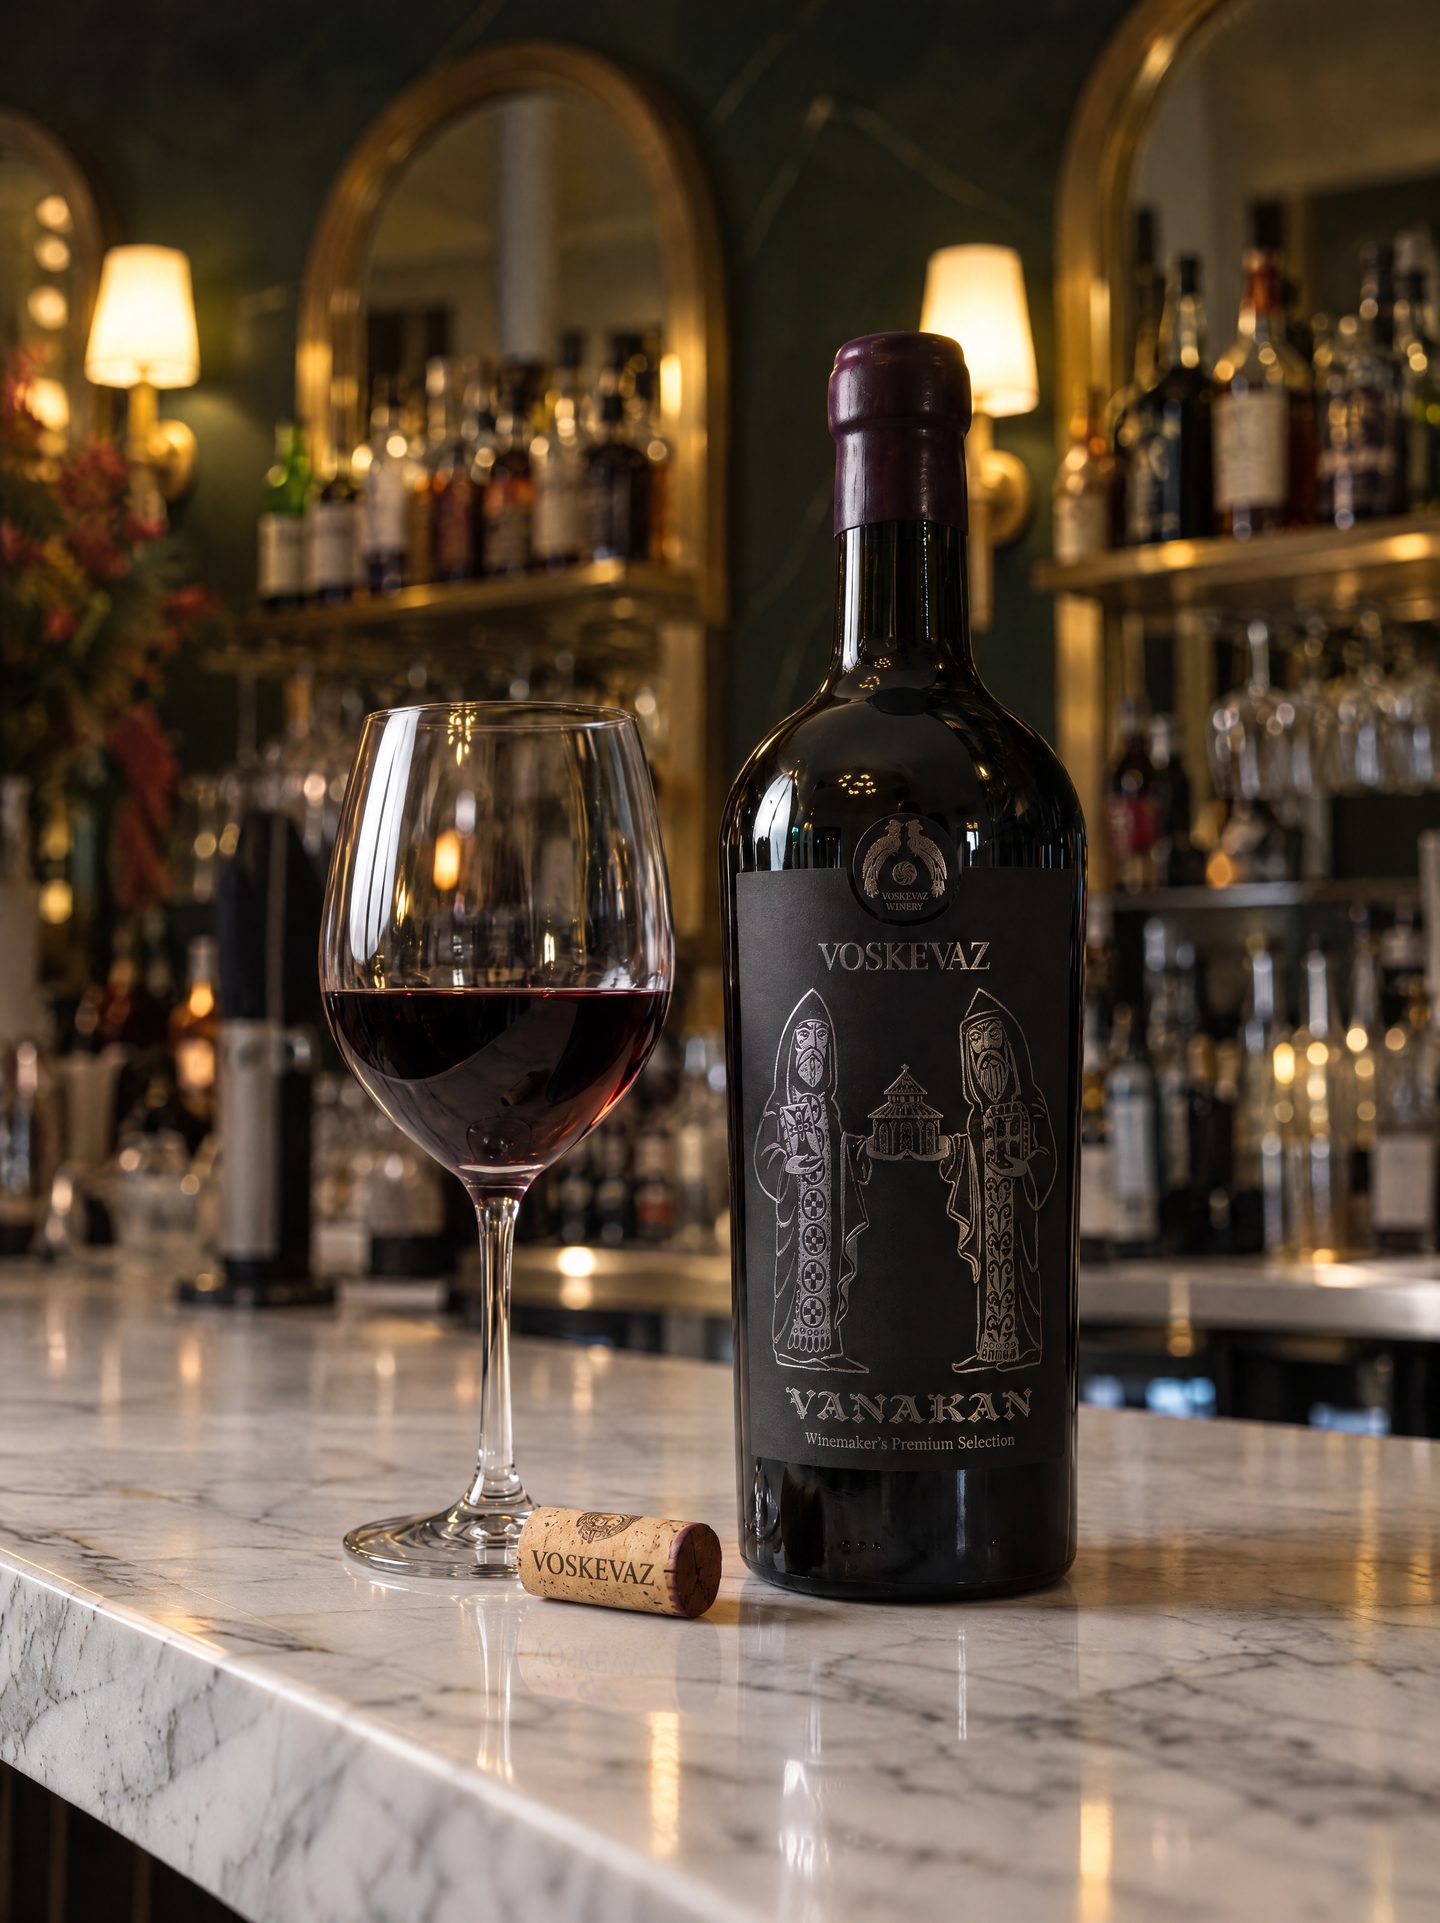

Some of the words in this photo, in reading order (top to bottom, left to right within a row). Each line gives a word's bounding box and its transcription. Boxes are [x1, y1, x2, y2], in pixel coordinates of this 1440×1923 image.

[882, 892, 928, 901] VOSKEVAZ
[886, 902, 924, 911] WINERY
[818, 941, 990, 971] VOSKEVAZ
[785, 1386, 1033, 1424] VANAKAN
[804, 1431, 888, 1450] Winemaker's
[891, 1436, 953, 1451] Premium
[958, 1434, 1015, 1449] Selection
[531, 1550, 655, 1586] VOSKEVAZ
